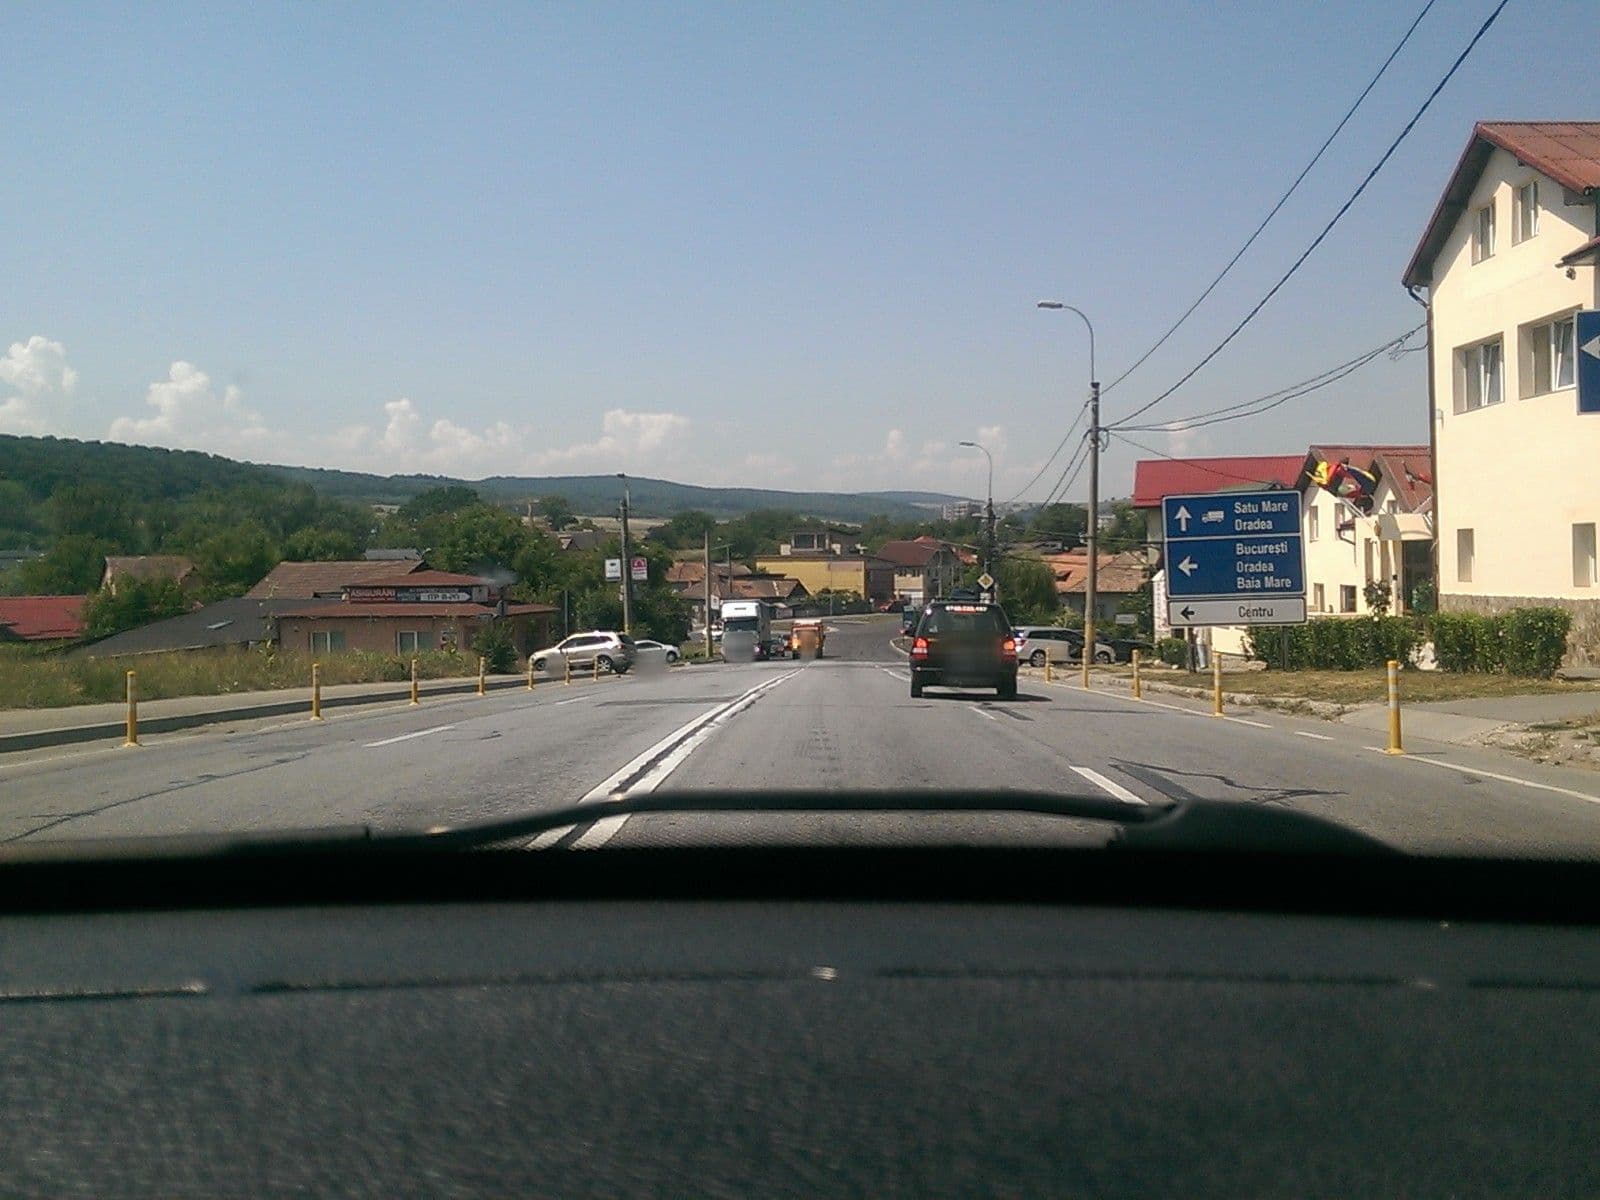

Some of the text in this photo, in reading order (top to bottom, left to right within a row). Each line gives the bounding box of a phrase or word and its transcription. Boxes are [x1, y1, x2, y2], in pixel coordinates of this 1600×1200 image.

[1234, 501, 1289, 514] Satu Mare
[1234, 518, 1273, 531] Oradea
[1236, 561, 1274, 573] Oradea
[1236, 576, 1292, 589] Baia Mare
[1238, 605, 1274, 618] Centru
